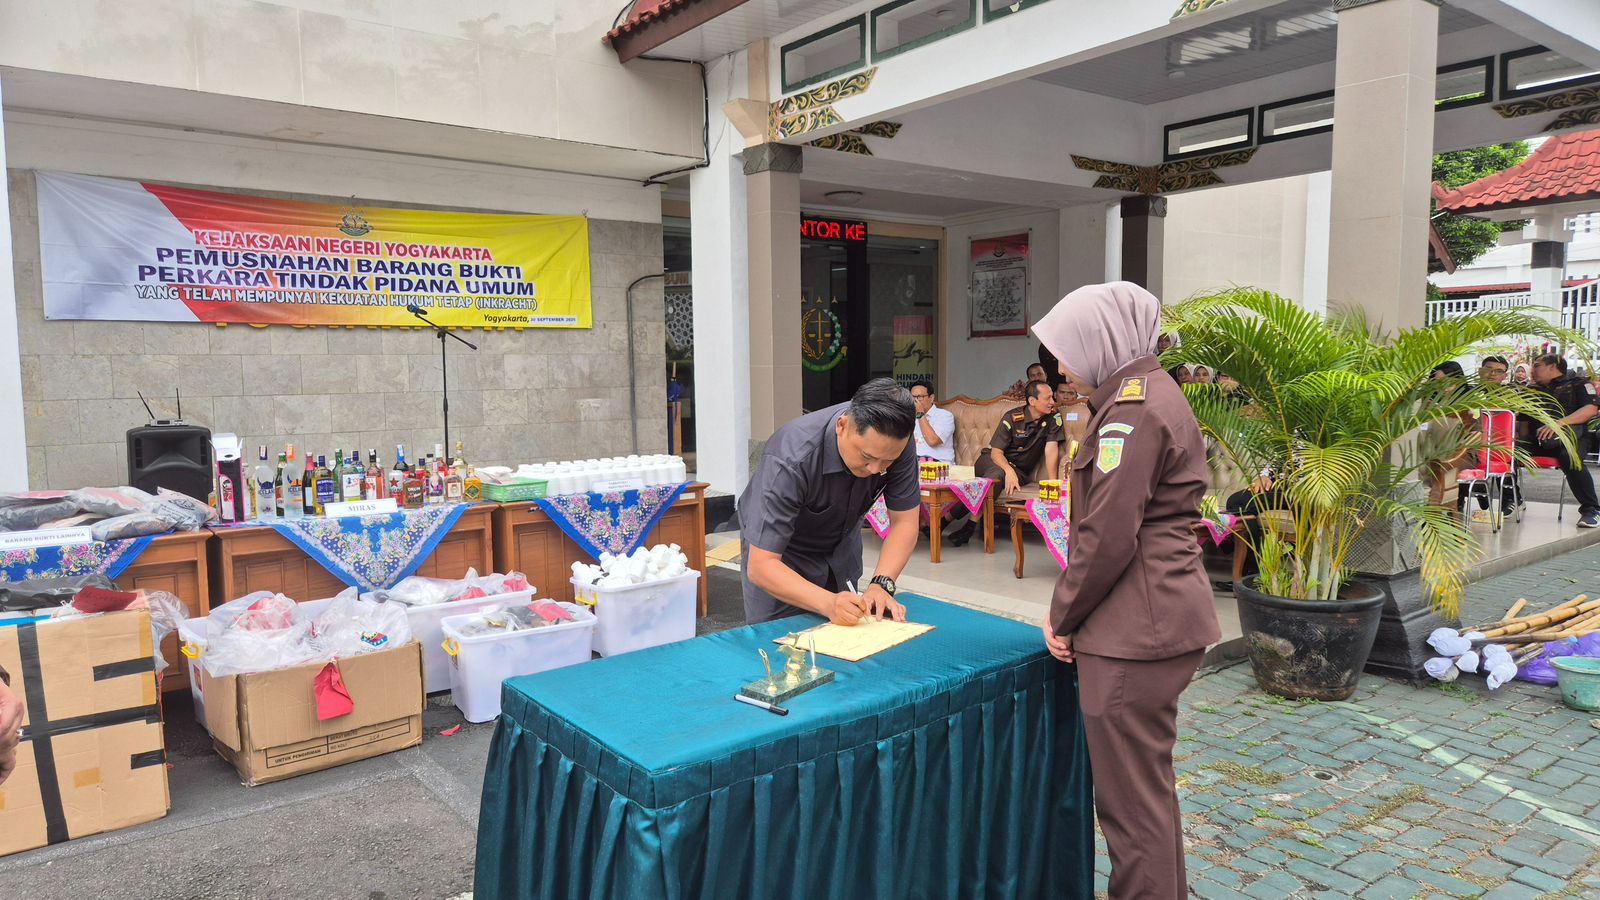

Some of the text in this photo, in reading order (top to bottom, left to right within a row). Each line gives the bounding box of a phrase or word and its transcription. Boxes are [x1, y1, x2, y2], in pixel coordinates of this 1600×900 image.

[193, 229, 492, 261] KEJAKSAAN NEGERI YOGYAKARTA
[845, 223, 865, 241] KE
[156, 247, 521, 280] PEMUSNAHAN BARANG BUKTI
[138, 265, 534, 296] PERKARA TINDAK PIDANA UMUM
[134, 284, 538, 311] YANG TELAH MEMPUNYAI KEKUATAN HUKUM TETAP (INKRACHT)
[483, 314, 529, 323] Yogyakarta,
[896, 373, 934, 381] HINDARI
